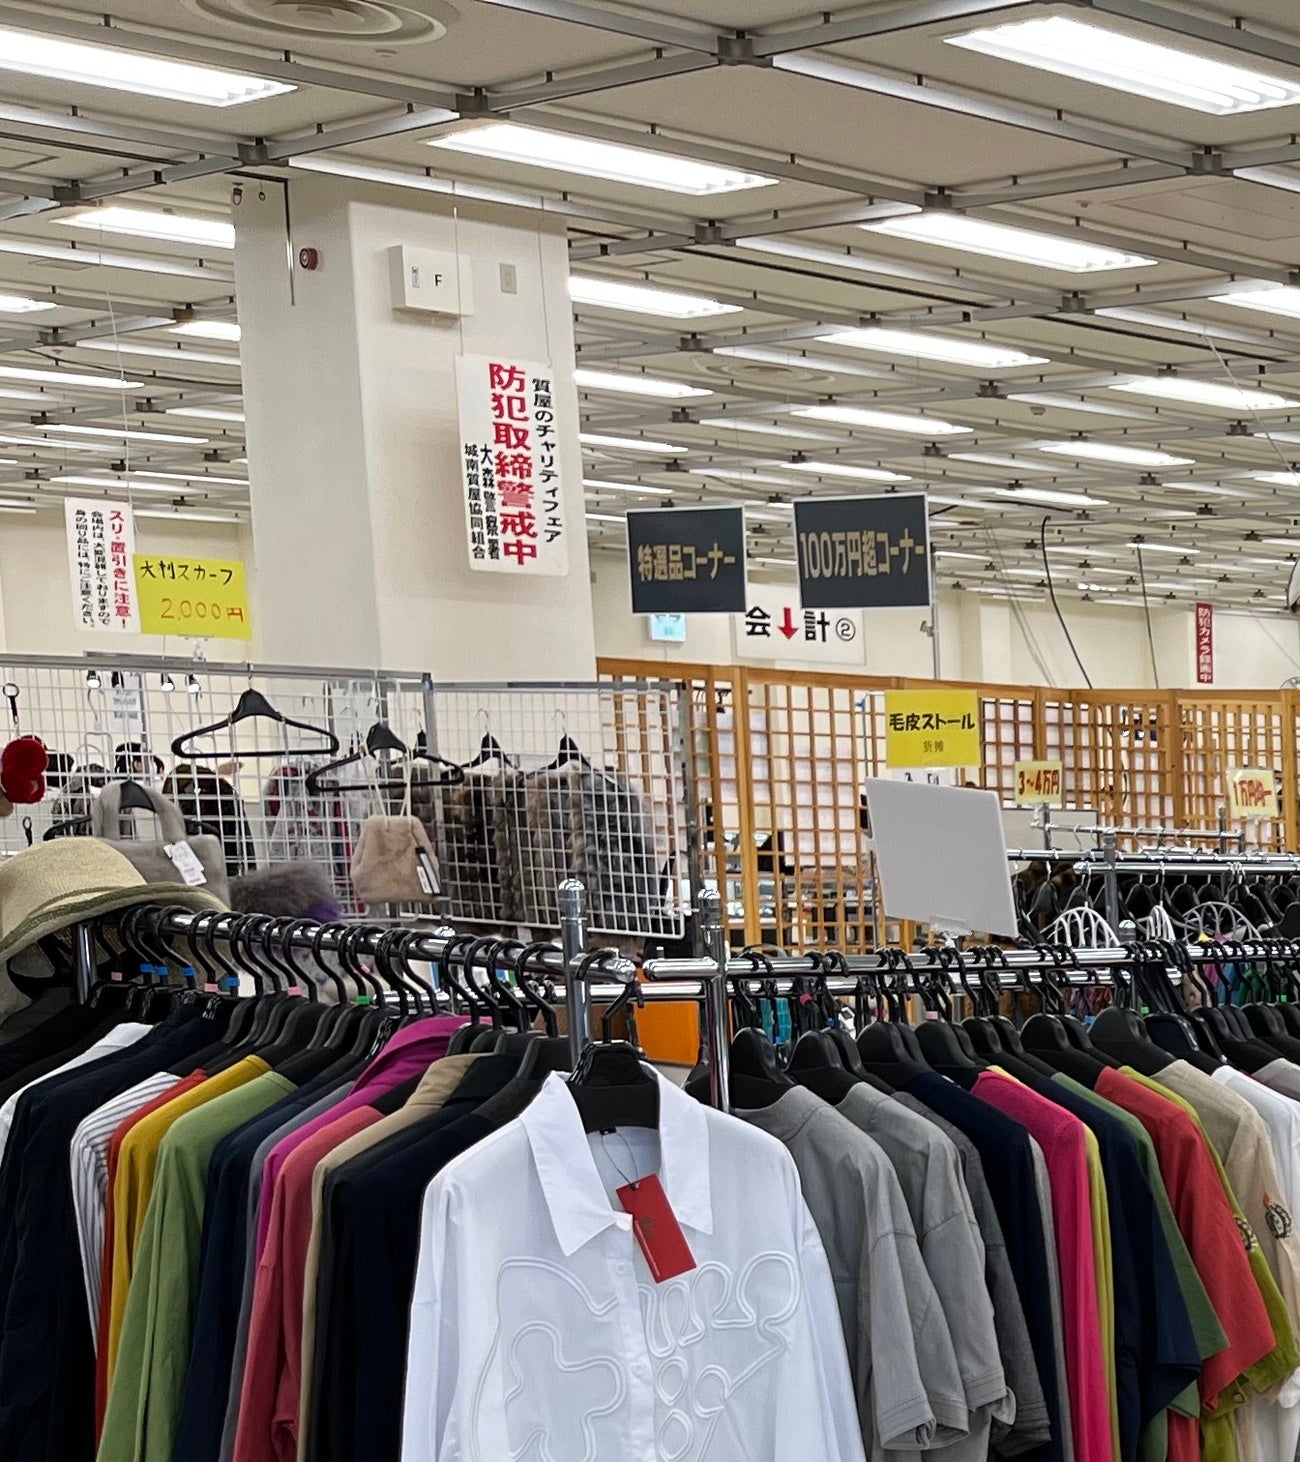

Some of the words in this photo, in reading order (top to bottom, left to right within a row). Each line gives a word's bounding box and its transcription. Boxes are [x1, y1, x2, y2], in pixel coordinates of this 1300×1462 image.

[488, 362, 538, 566] 防犯取締警戒中
[140, 560, 233, 586] 大判スカーフ
[637, 542, 736, 583] 特選品コーナー
[799, 527, 925, 579] 100万円超コーナー
[888, 709, 976, 733] 毛皮ストール
